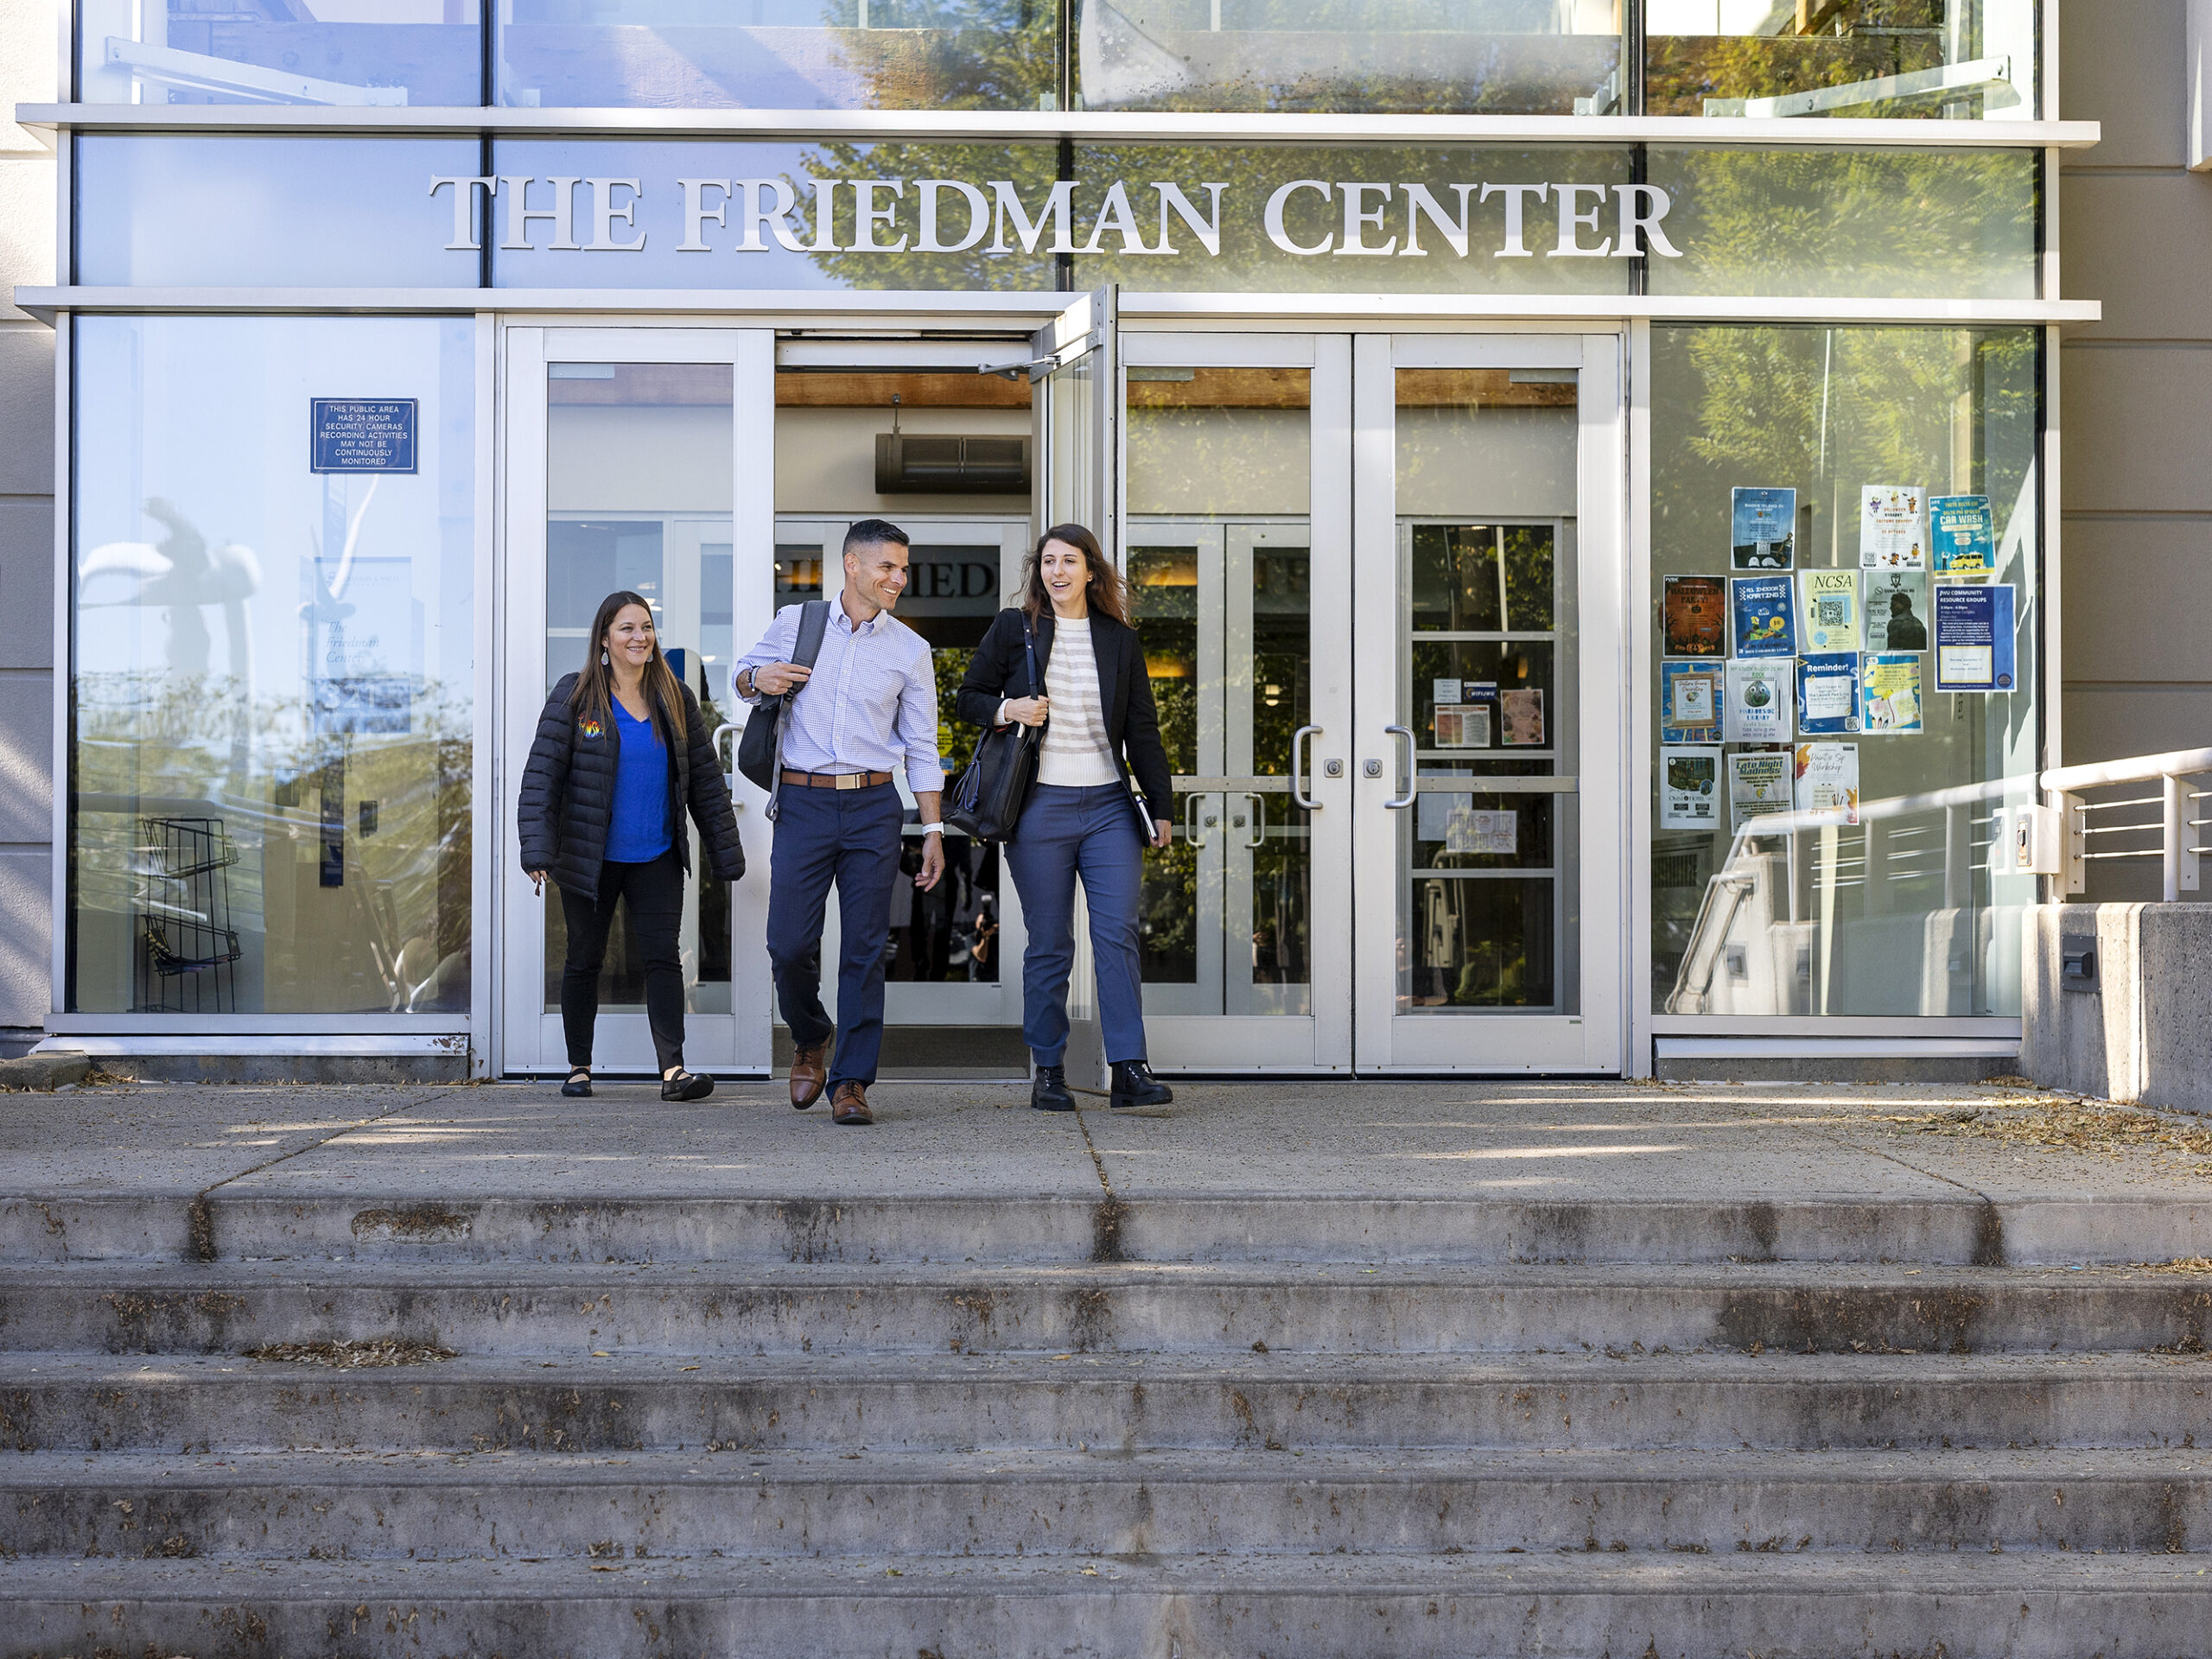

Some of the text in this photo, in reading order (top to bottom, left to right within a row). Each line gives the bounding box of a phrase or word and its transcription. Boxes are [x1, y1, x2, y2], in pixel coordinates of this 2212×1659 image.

[429, 175, 1684, 258] THE FRIEDMAN CENTER
[1940, 514, 1983, 524] CAR WASH
[1815, 575, 1853, 588] NCSA
[1670, 587, 1719, 595] HALLOWEEN
[1681, 595, 1708, 604] PARTY!
[326, 635, 380, 648] Friedman
[1807, 664, 1849, 673] Reminder!
[318, 683, 376, 709] 321
[1758, 760, 1783, 769] Night
